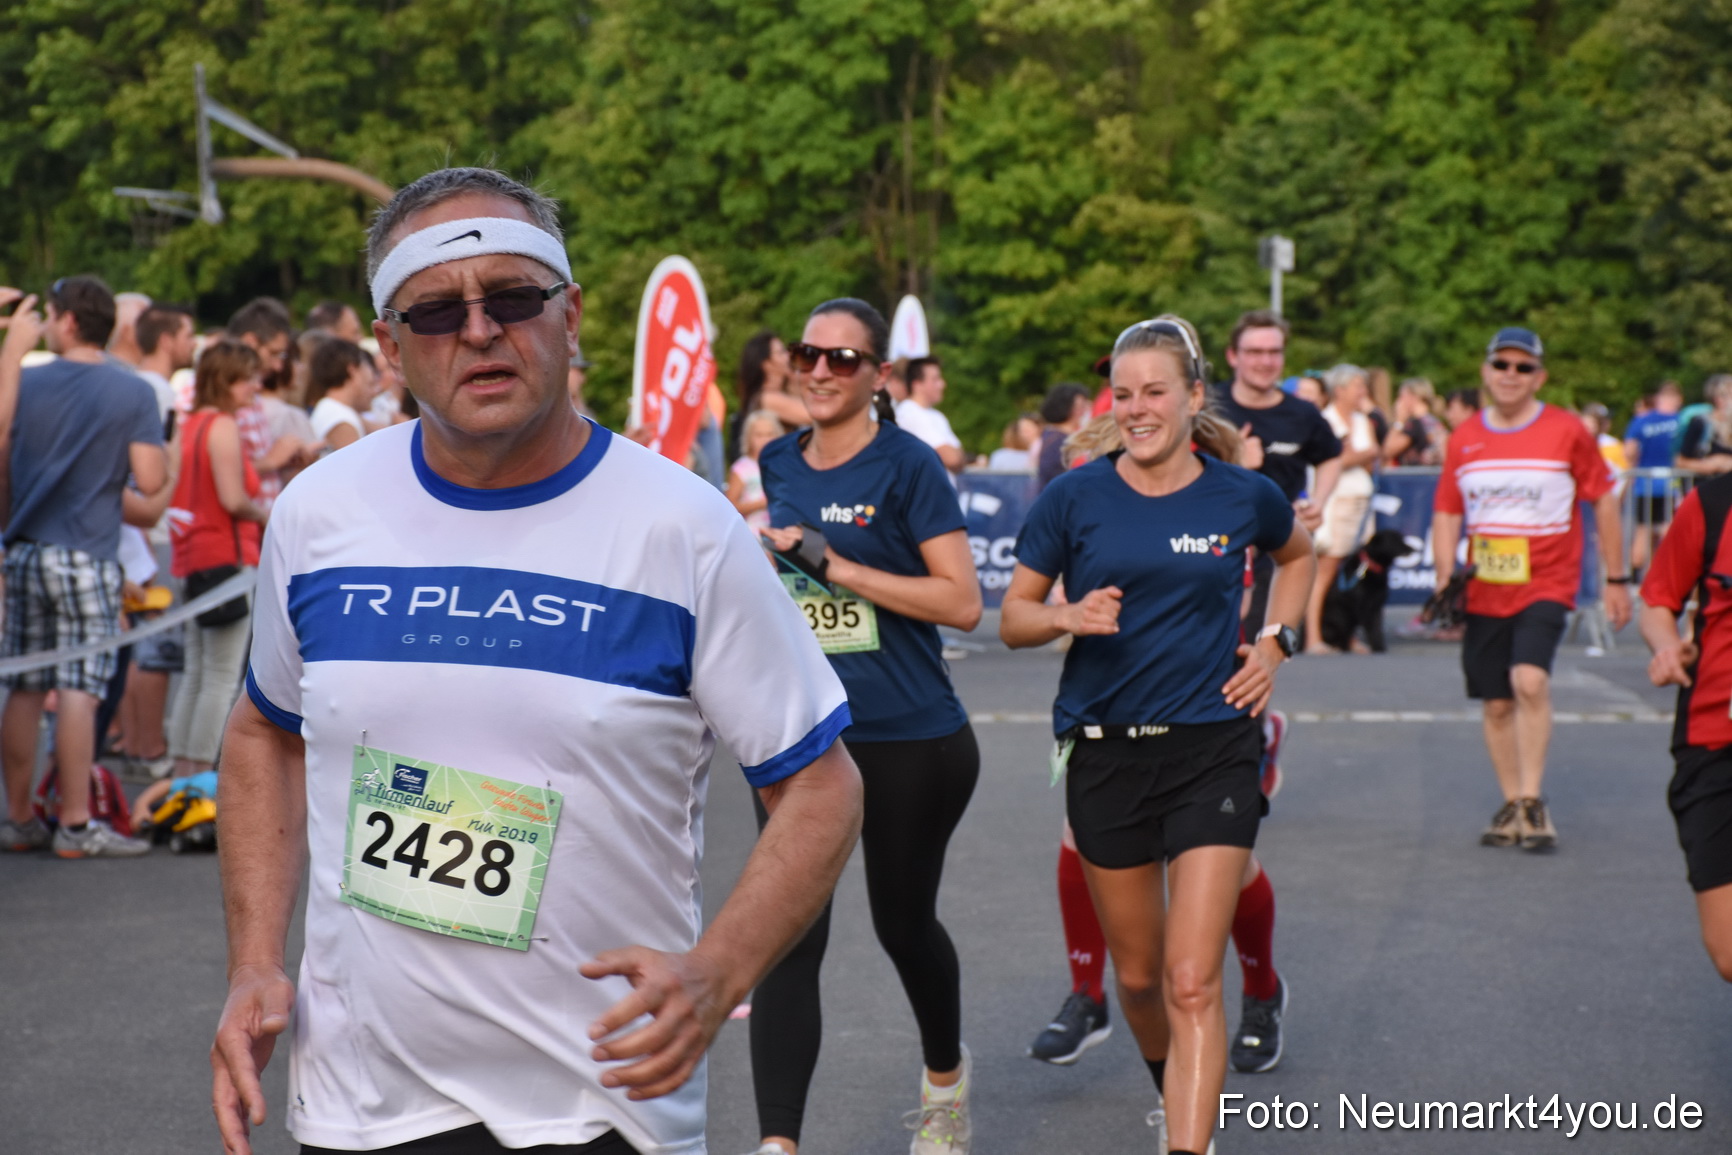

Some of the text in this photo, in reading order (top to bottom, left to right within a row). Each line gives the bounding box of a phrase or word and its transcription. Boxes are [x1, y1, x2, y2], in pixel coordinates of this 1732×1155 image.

[820, 502, 854, 524] vhs
[1170, 533, 1209, 554] vhs
[407, 585, 606, 632] PLAST
[800, 601, 860, 630] 395
[401, 633, 523, 649] GROUP
[376, 783, 455, 814] firmenlauf
[467, 819, 538, 844] run 2019
[361, 810, 515, 897] 2428
